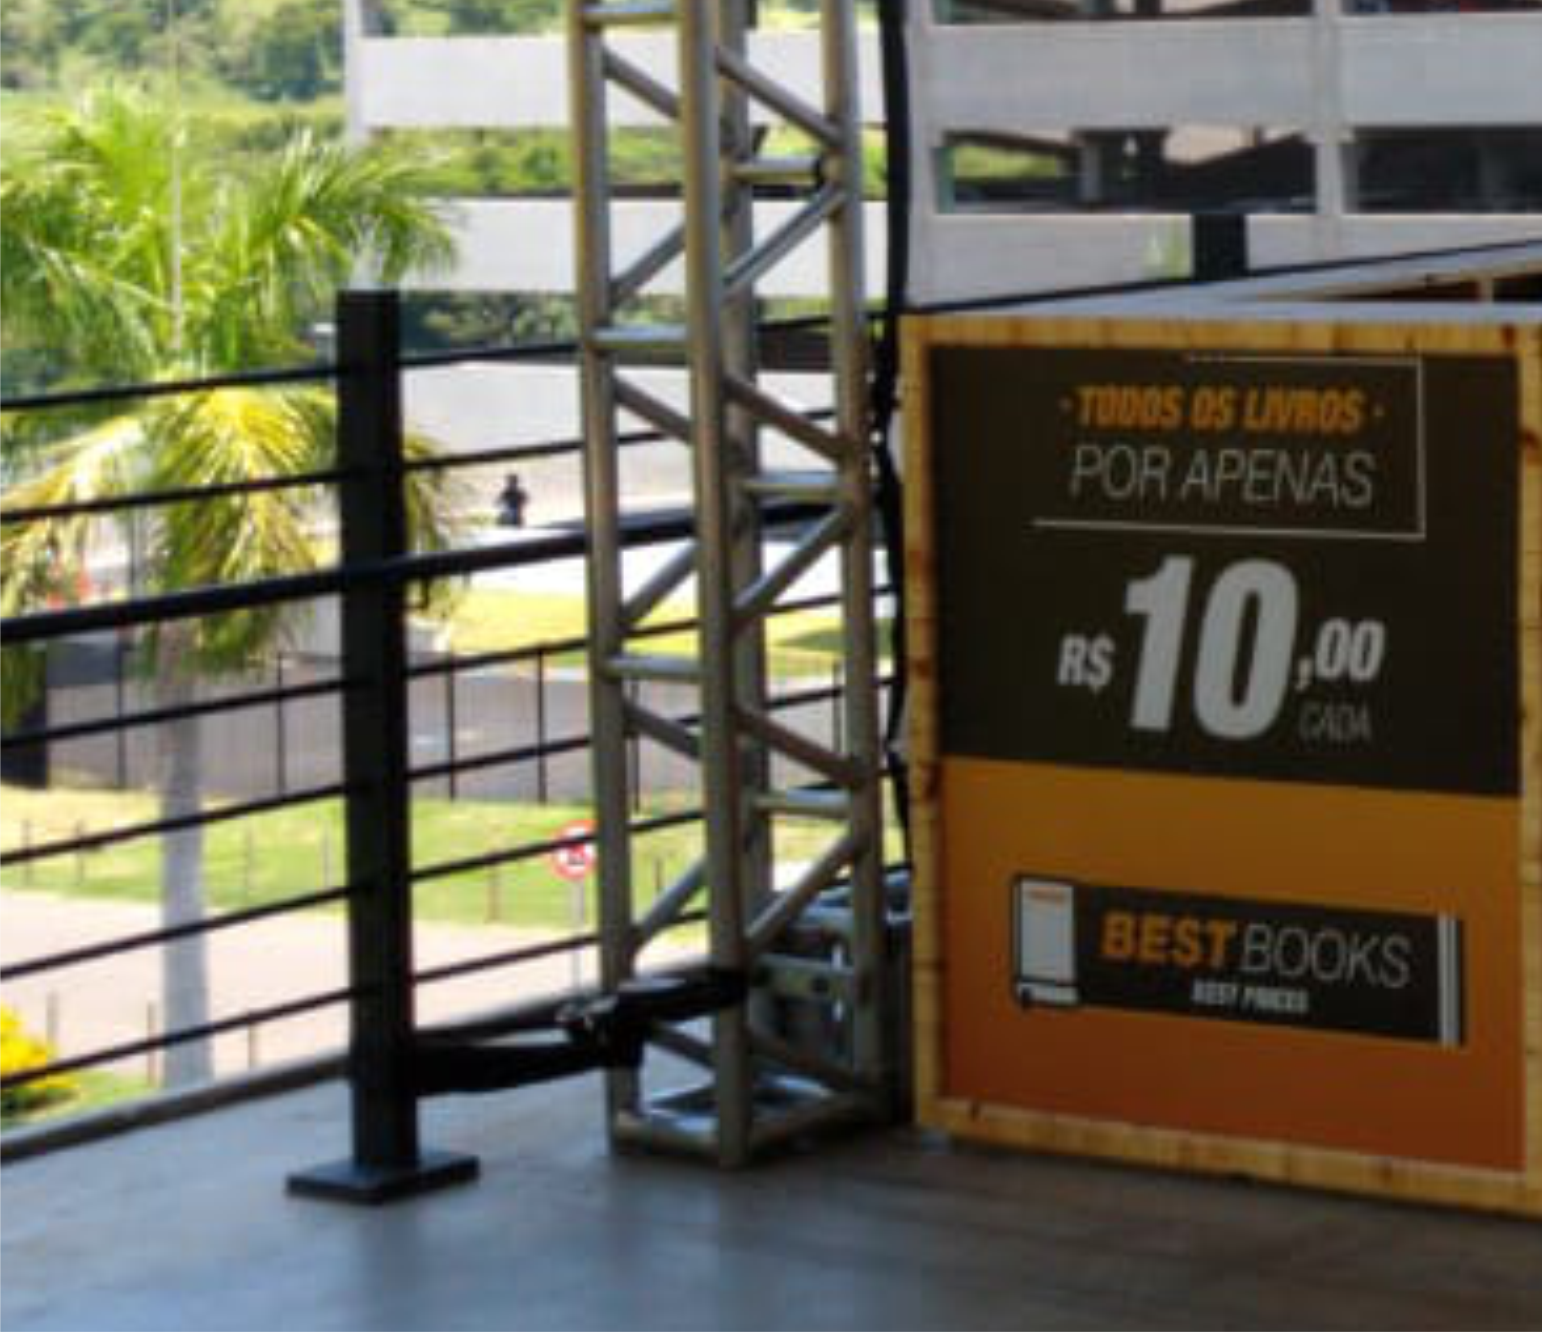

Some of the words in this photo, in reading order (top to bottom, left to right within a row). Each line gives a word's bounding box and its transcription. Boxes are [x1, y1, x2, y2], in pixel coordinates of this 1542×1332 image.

[1077, 384, 1184, 430] TODOS
[1190, 385, 1237, 431] OS
[1243, 387, 1366, 433] LIVROS
[1069, 443, 1171, 499] POR
[1179, 447, 1376, 508] APENAS
[1057, 632, 1116, 694] R$
[1298, 701, 1372, 742] CADA
[1101, 911, 1238, 968] BEST
[1239, 922, 1413, 988] BOOKS
